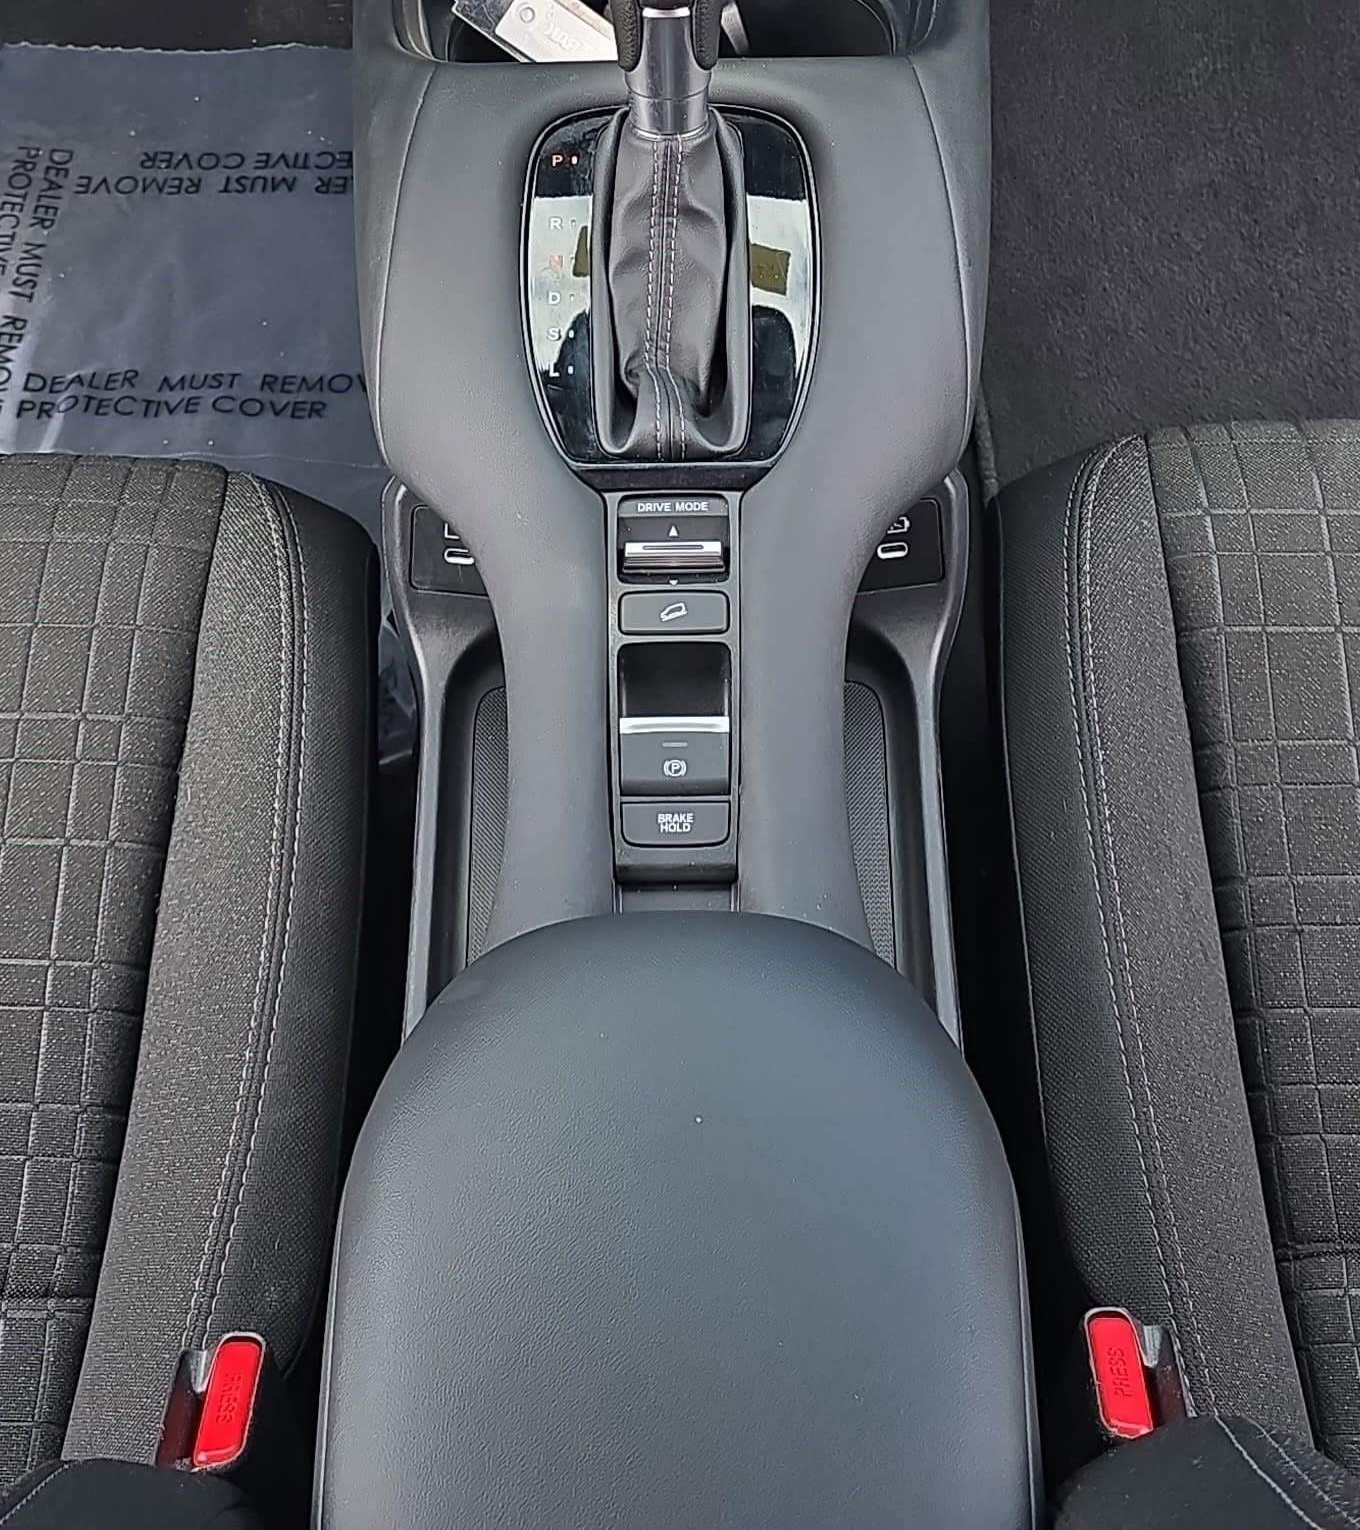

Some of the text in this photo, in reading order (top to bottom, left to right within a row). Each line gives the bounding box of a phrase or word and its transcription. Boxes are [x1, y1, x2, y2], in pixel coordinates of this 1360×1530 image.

[139, 150, 354, 171] ECTIVE COVER
[551, 154, 564, 167] P
[30, 147, 74, 232] DEALER
[73, 175, 202, 196] REMOVE
[218, 176, 297, 195] MUST
[549, 217, 562, 230] R
[548, 255, 564, 268] N
[11, 241, 48, 304] MUST
[548, 292, 561, 305] D
[548, 327, 562, 341] S
[549, 363, 560, 377] L
[22, 369, 367, 396] DEALER MUST REMO
[16, 394, 329, 421] PROTECTIVE COVER
[637, 500, 709, 512] DRIVE MODE
[657, 813, 694, 824] BRAKE
[659, 823, 691, 833] HOLD
[1106, 1346, 1133, 1398] PRESS
[216, 1373, 242, 1423] PRESS
